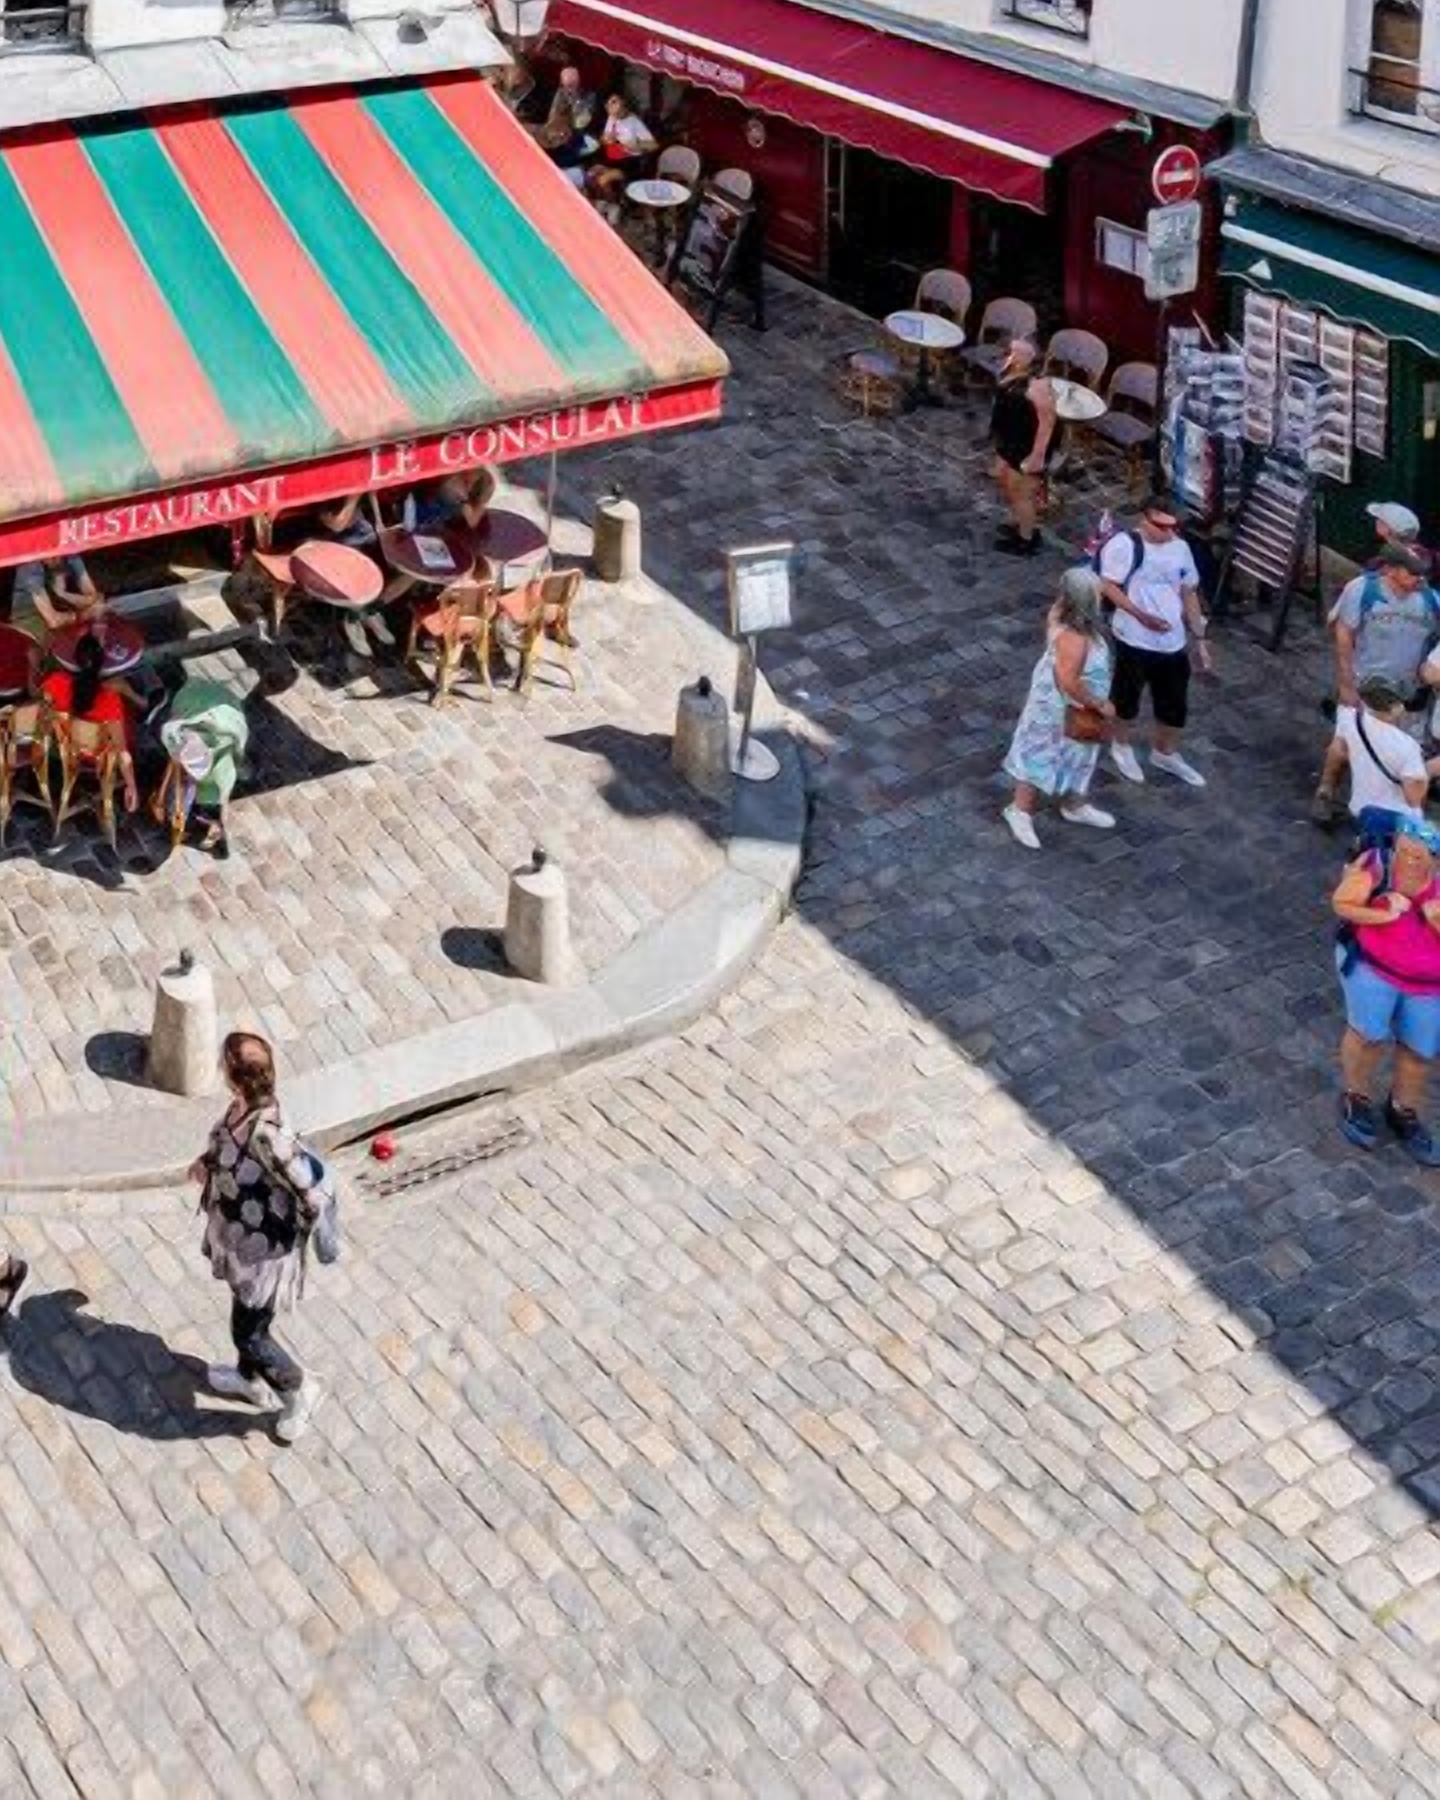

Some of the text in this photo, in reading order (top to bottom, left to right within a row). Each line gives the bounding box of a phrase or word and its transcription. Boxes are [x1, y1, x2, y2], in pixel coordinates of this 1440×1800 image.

[59, 390, 650, 546] RESTAURANT LE CONSULAT
